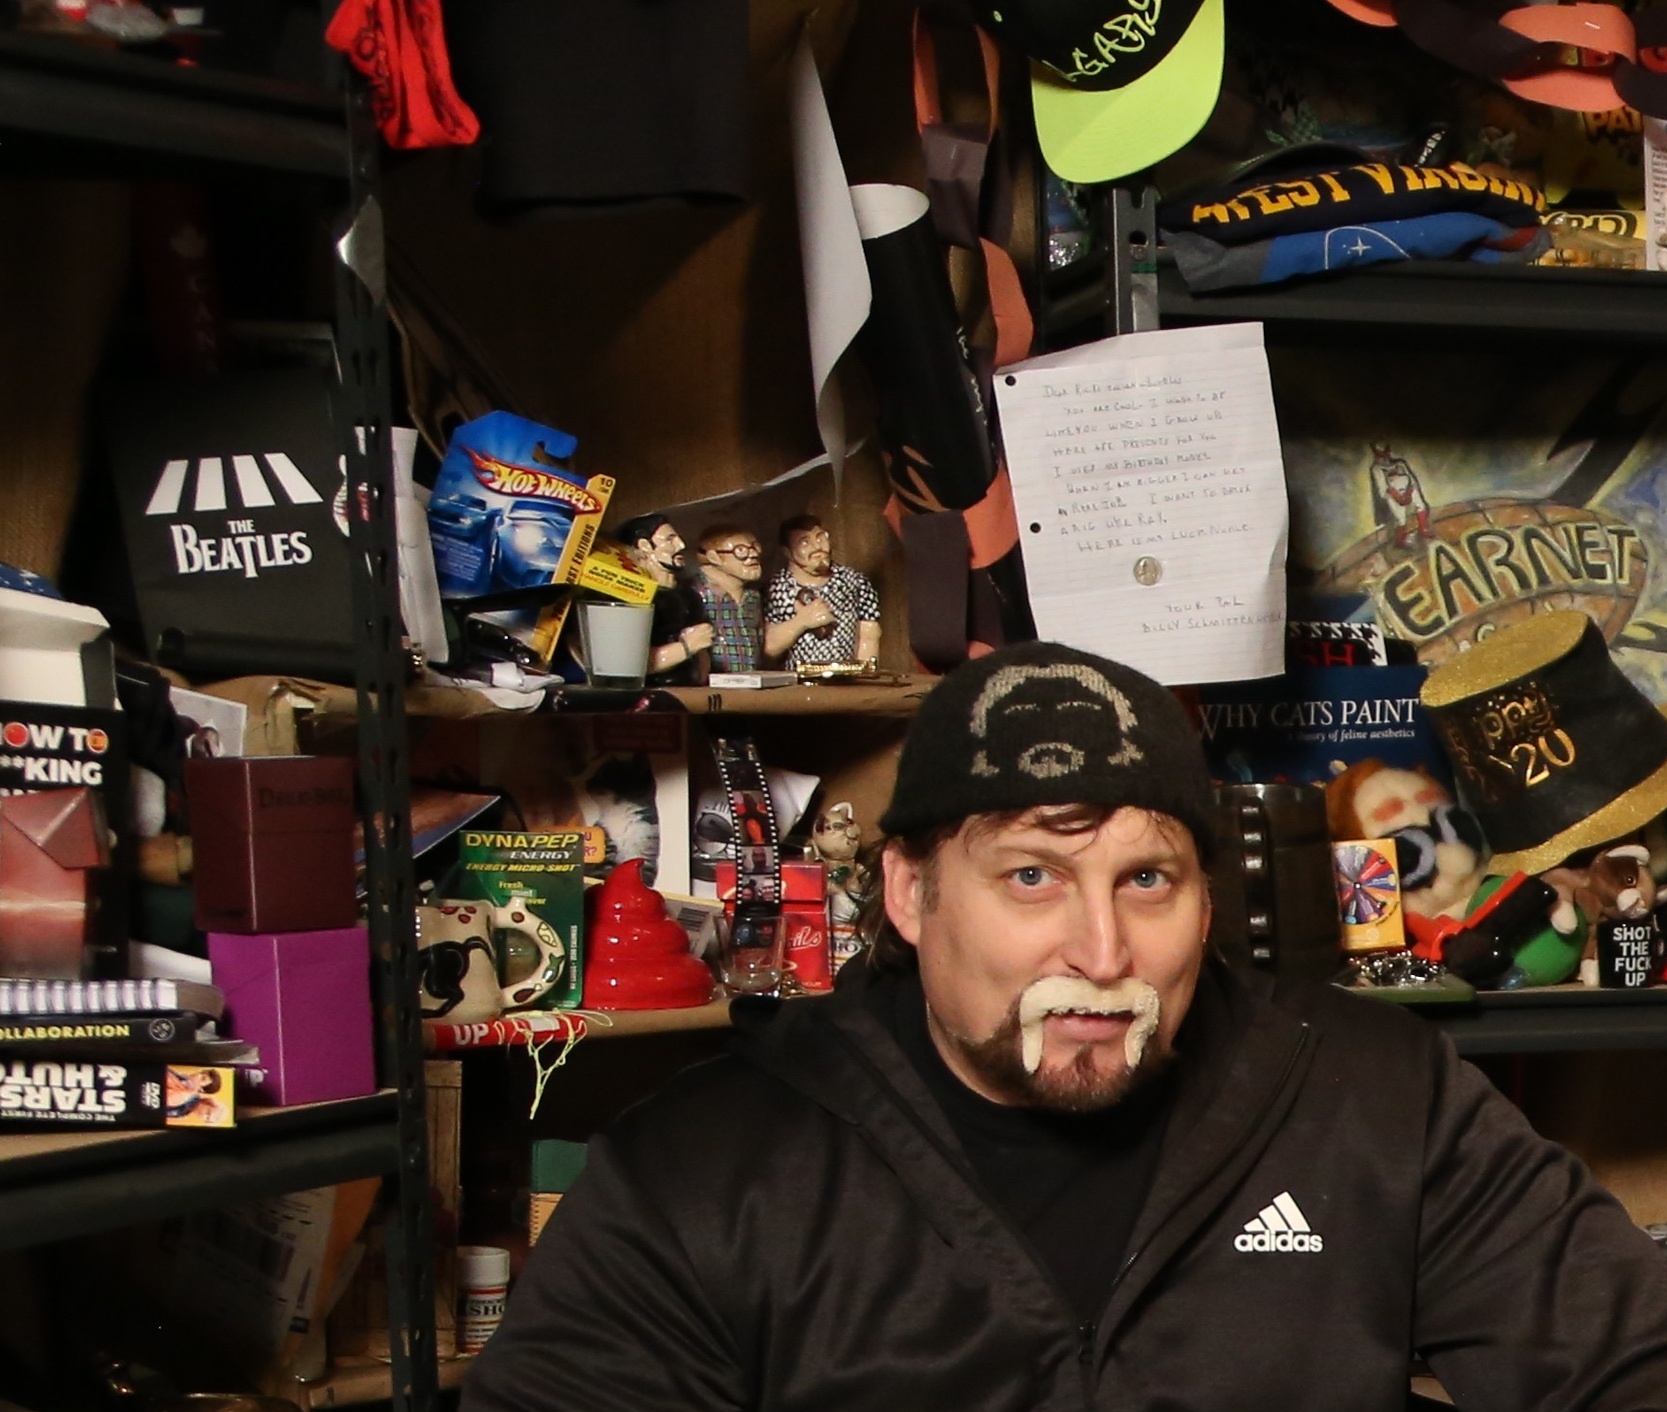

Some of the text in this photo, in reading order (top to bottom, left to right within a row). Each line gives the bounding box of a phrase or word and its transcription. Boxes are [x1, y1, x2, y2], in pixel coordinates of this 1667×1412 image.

[227, 519, 255, 534] THE
[576, 523, 597, 566] EDITIONS
[1197, 697, 1419, 743] WHY CATS PAINT
[1328, 729, 1339, 743] of
[1340, 728, 1367, 744] feline
[1369, 727, 1416, 741] aesthetics
[509, 850, 573, 860] ENERGY
[465, 863, 508, 872] ENERGY
[499, 880, 524, 890] Fresh
[1612, 925, 1651, 942] SHOT
[1619, 942, 1649, 956] THE
[1614, 956, 1651, 972] FUCK
[1625, 971, 1646, 987] UP
[452, 1022, 490, 1046] UP
[97, 1064, 128, 1087] &
[1234, 1227, 1324, 1254] adidas
